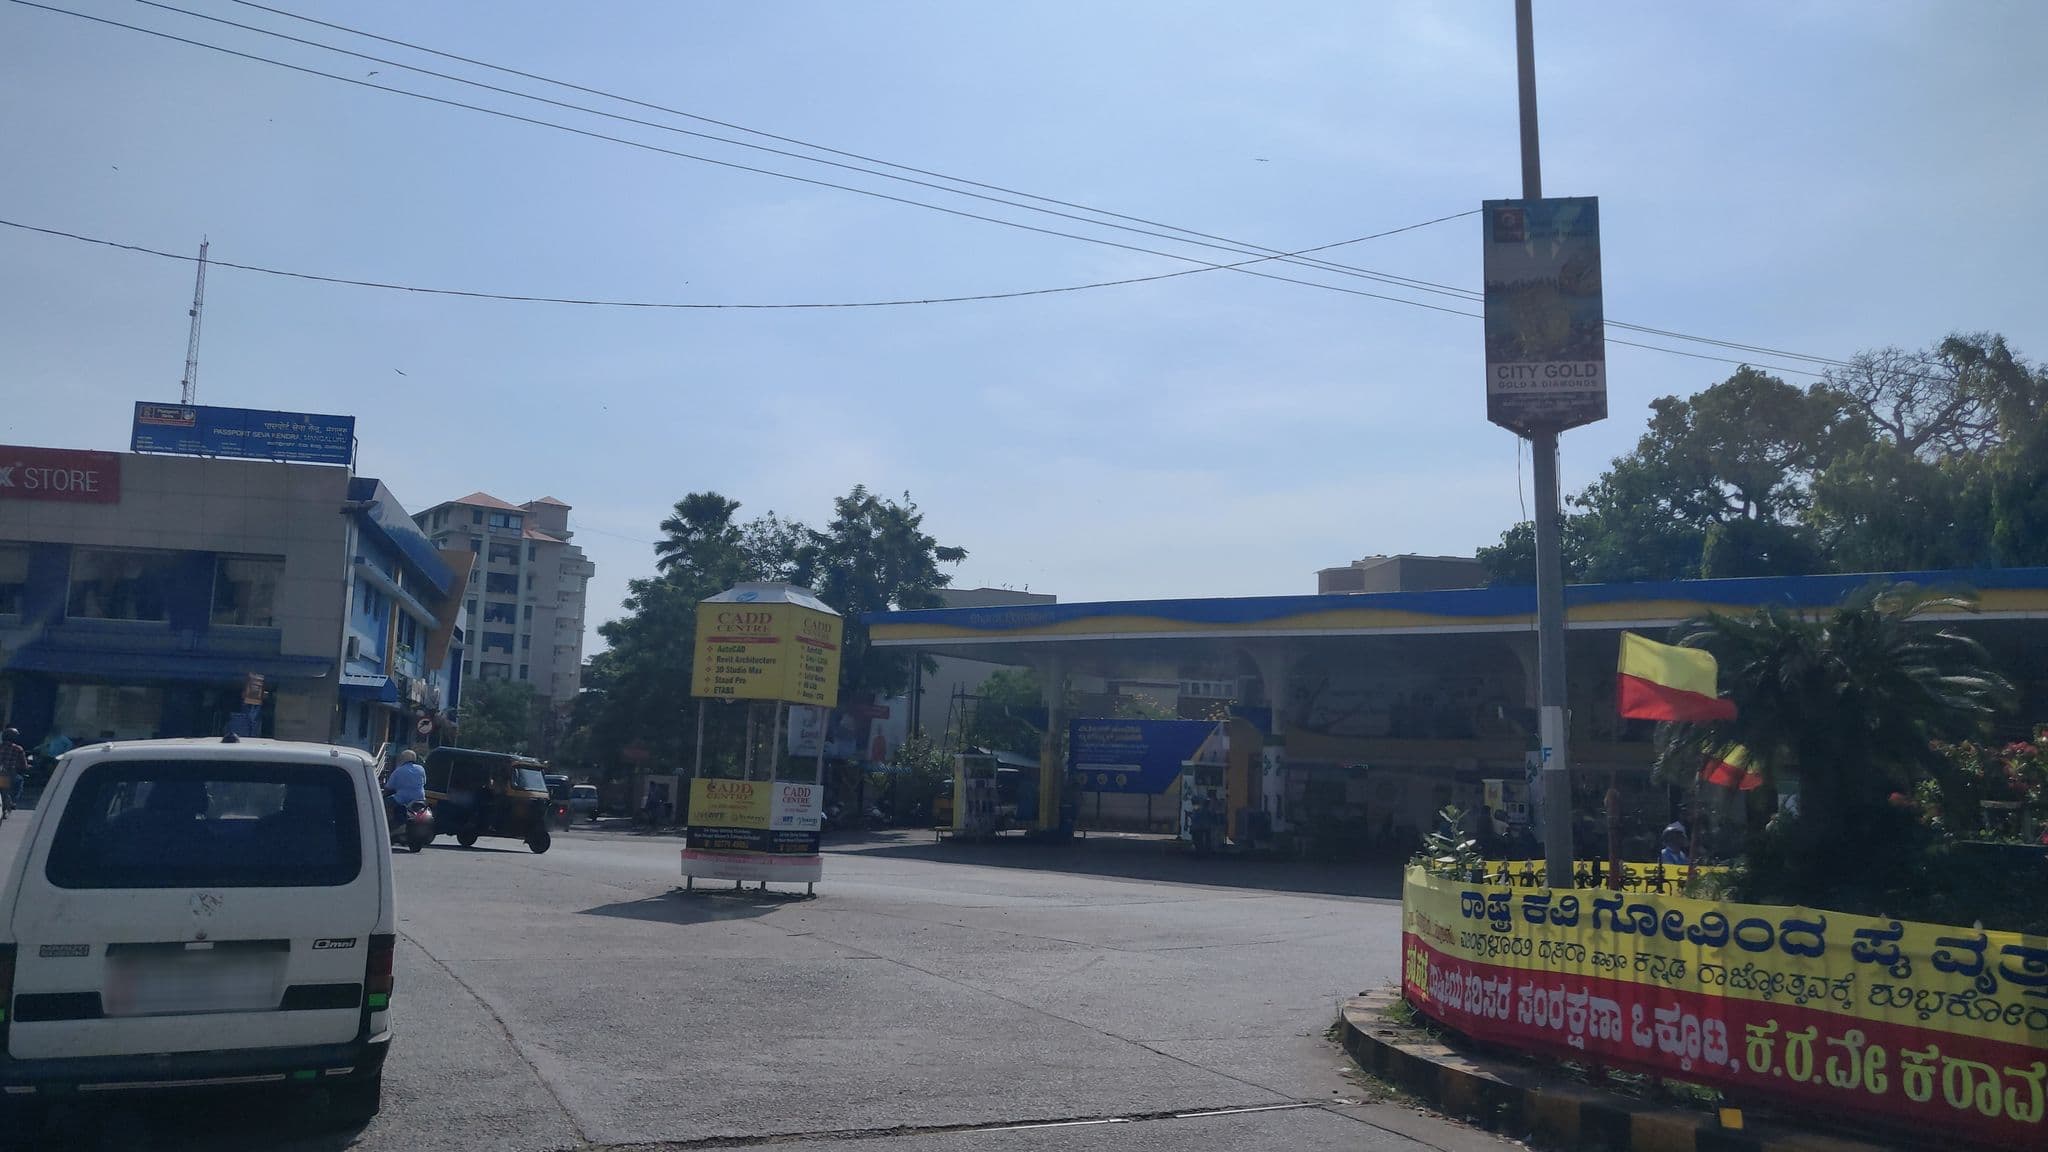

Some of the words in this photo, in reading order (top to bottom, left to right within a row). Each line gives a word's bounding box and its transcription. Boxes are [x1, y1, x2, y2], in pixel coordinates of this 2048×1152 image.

[1497, 365, 1538, 379] CITY
[1544, 364, 1597, 378] GOLD
[213, 428, 251, 438] PASSPORT
[24, 467, 99, 493] STORE
[718, 612, 773, 625] CADD
[725, 666, 746, 675] Studio
[706, 782, 753, 794] CADD
[783, 786, 811, 798] CADD
[1521, 890, 1580, 927] ಕವಿ
[1592, 893, 1827, 958] ಗೋವಿಂದ
[315, 939, 354, 949] Omni
[1634, 951, 1686, 984] ಕನ್ನಡ
[1900, 1044, 2048, 1123] ಕರಾವ
